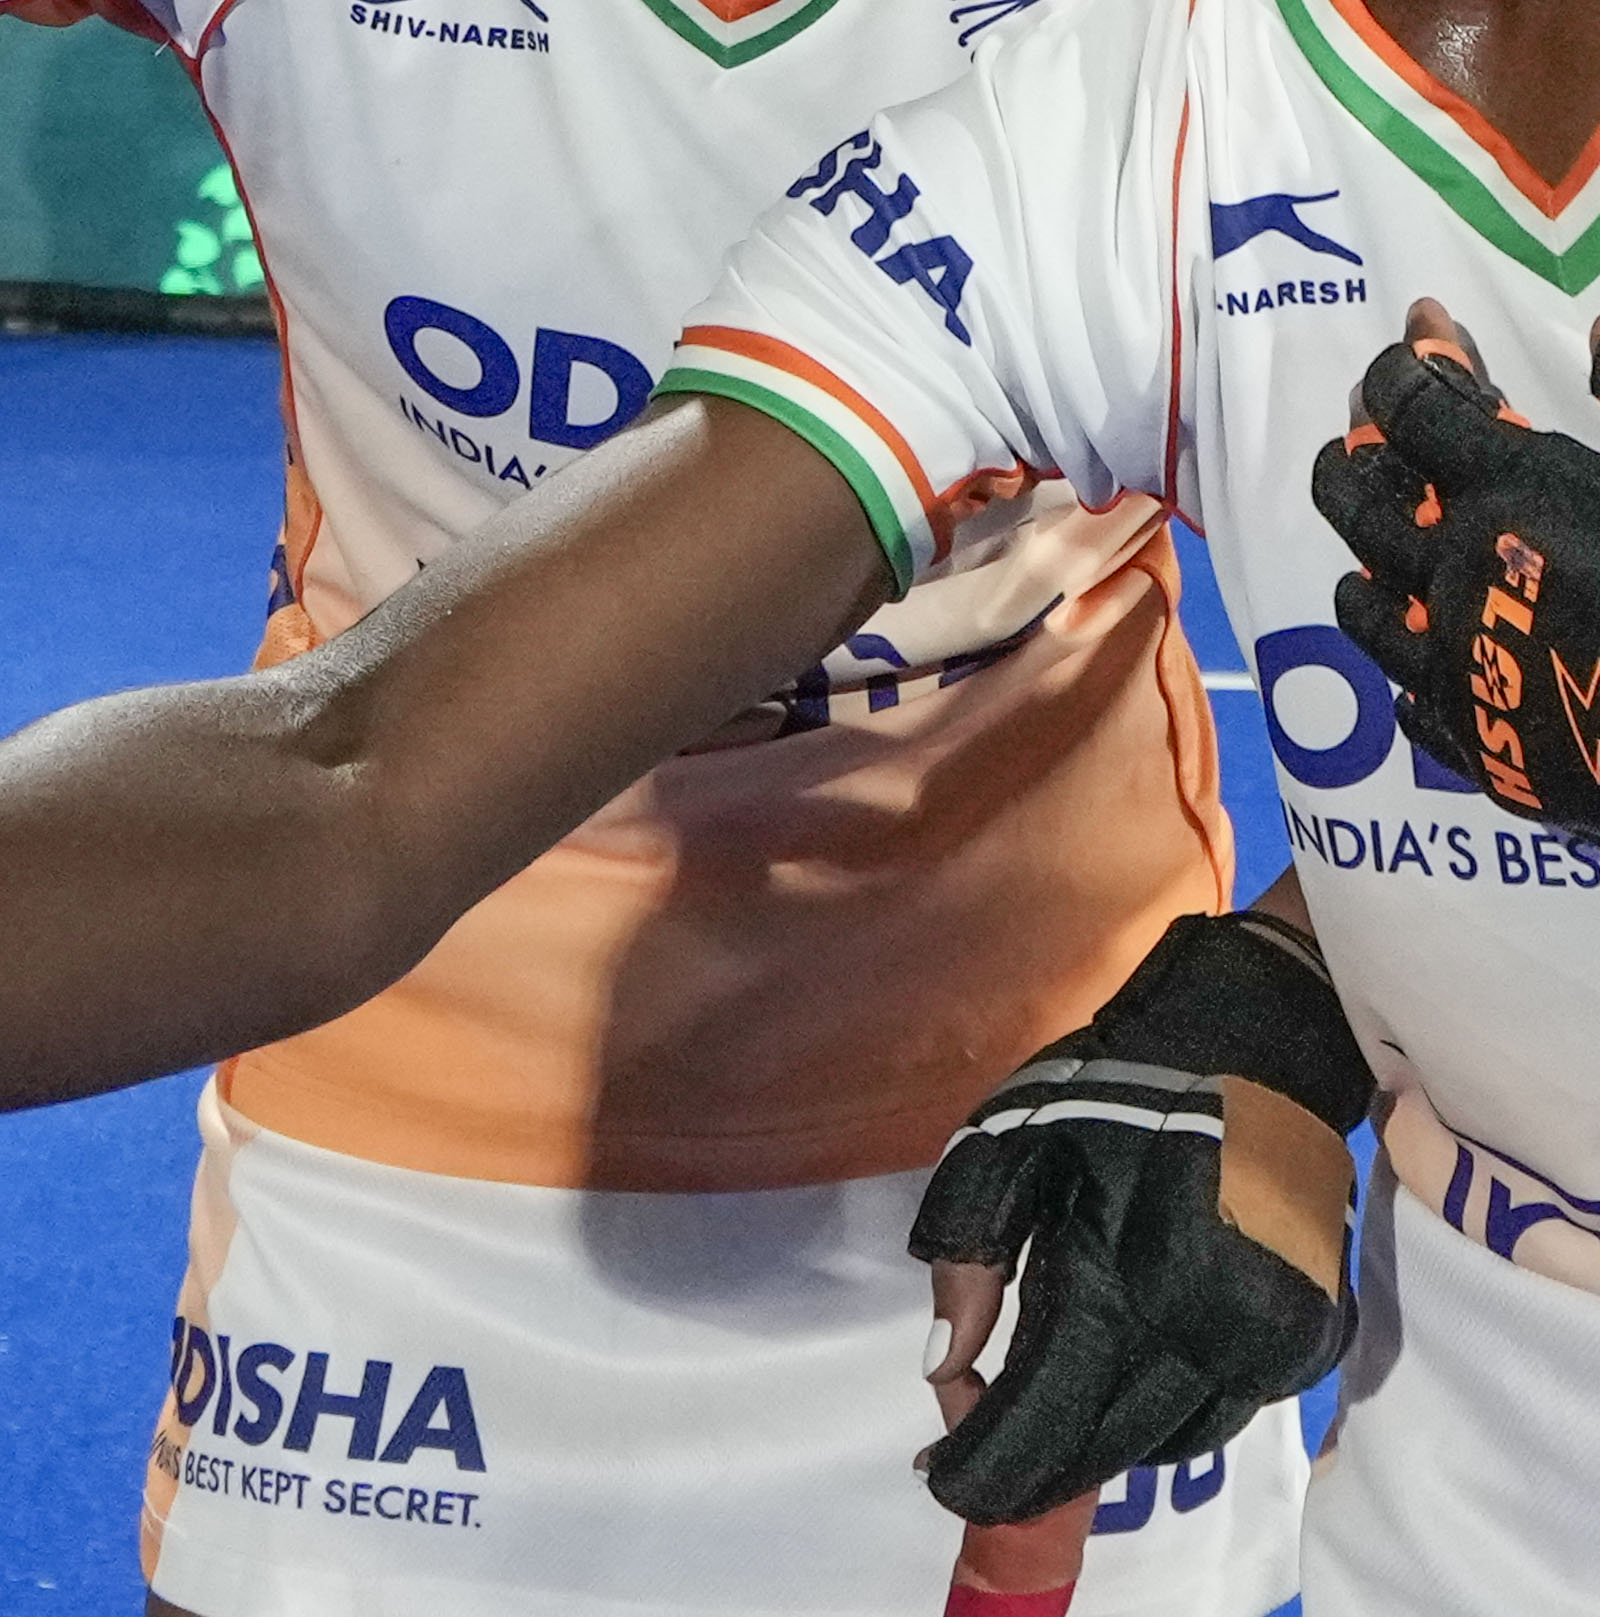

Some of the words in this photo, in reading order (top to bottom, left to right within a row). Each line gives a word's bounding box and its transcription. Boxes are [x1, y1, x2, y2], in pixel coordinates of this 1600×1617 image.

[350, 3, 549, 53] SHIV-NARESH
[384, 295, 656, 450] OD
[184, 1450, 235, 1496] BEST
[241, 1464, 311, 1510] KEPT
[322, 1480, 484, 1530] SECRET.
